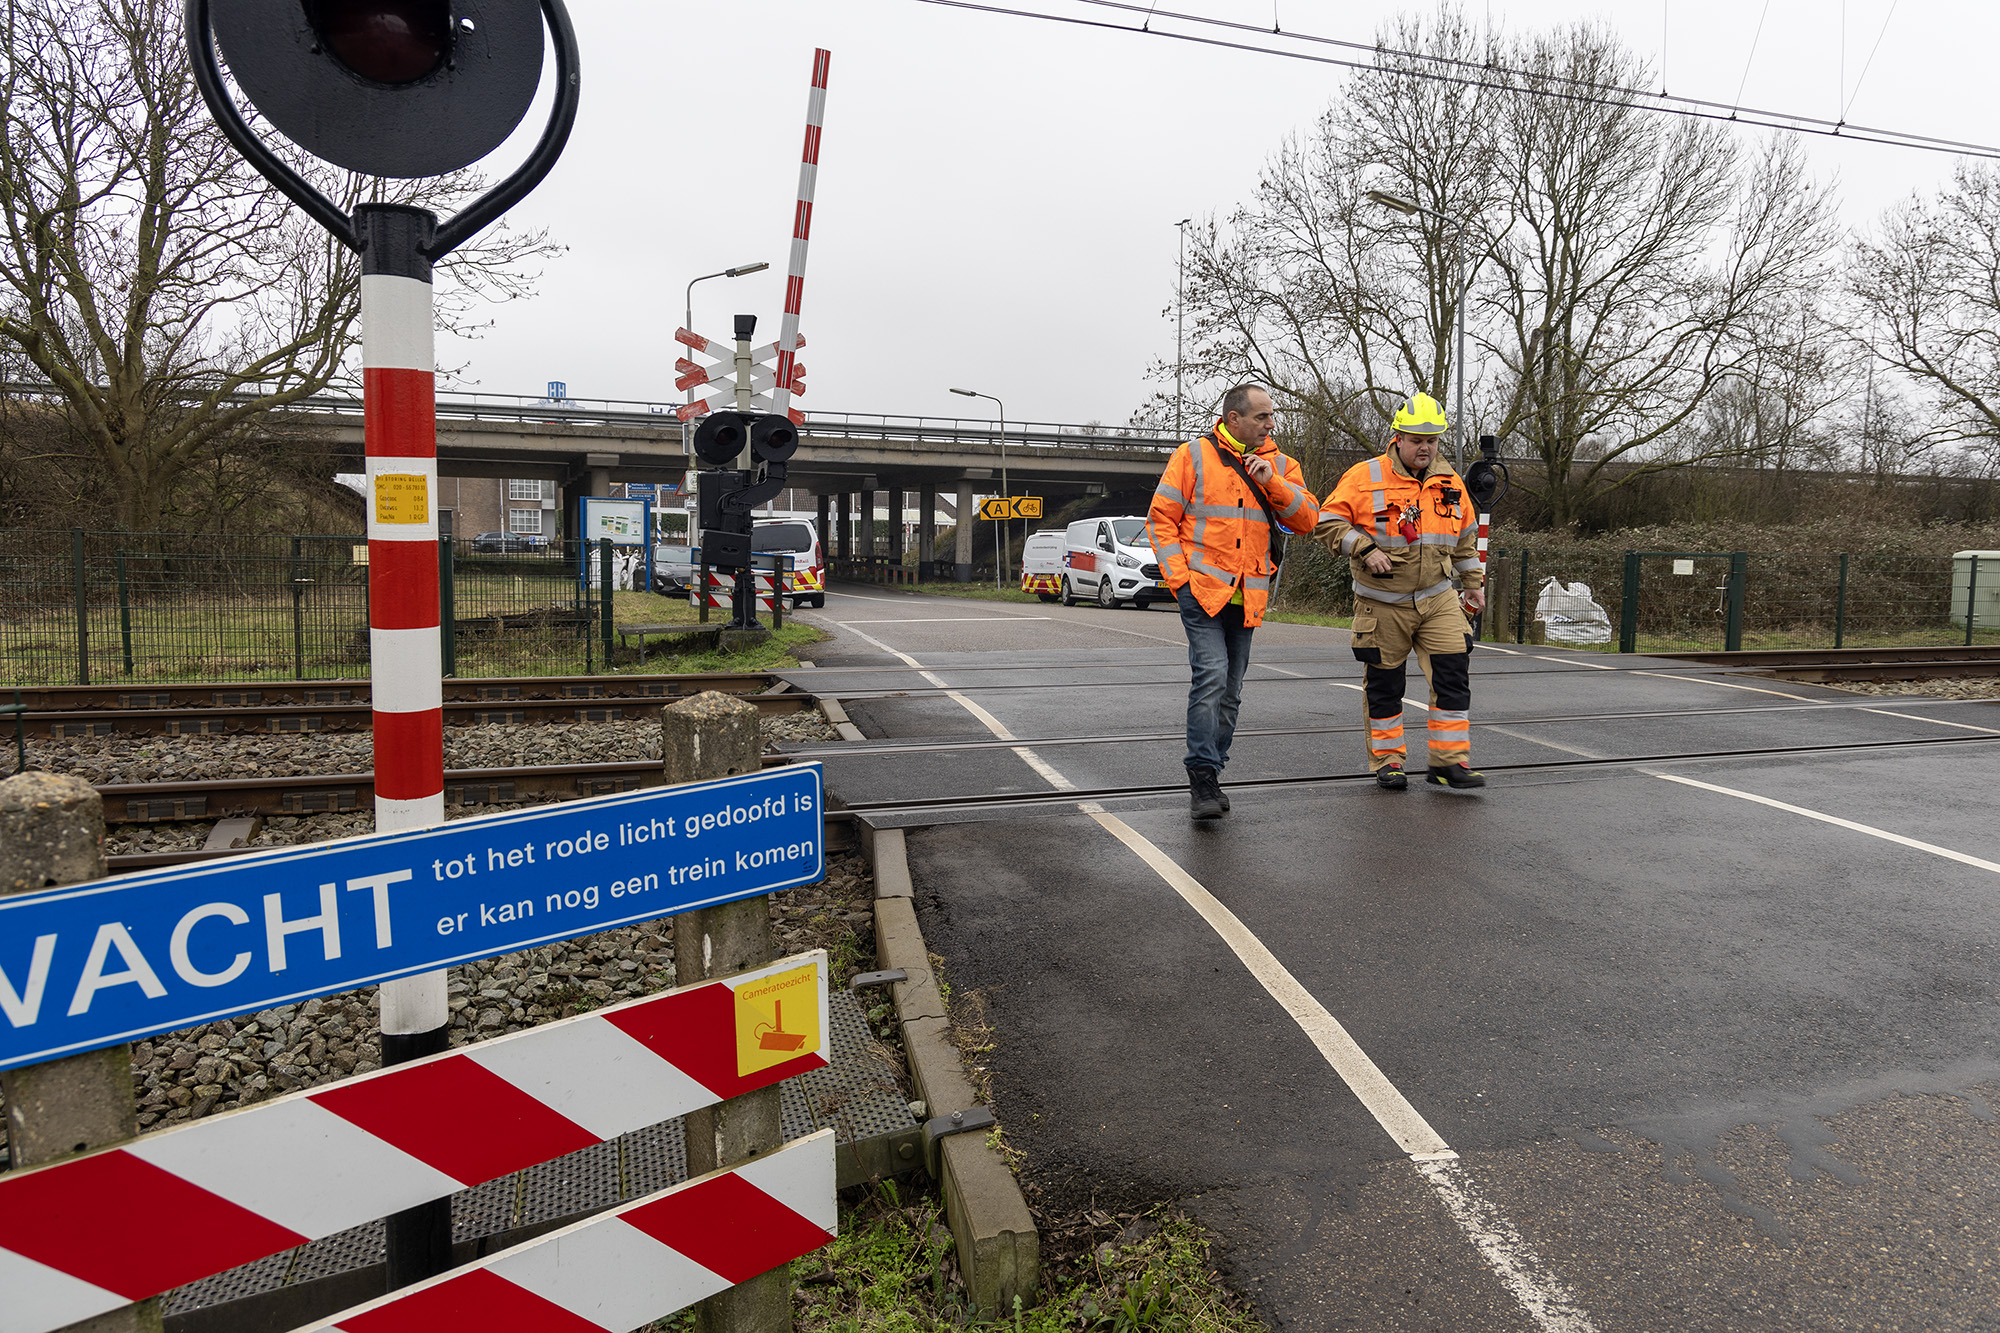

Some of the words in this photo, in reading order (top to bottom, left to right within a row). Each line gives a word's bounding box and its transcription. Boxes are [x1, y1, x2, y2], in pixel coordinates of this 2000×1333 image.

[994, 503, 1003, 515] A
[431, 853, 477, 881] tot
[487, 842, 536, 873] het
[546, 830, 610, 861] rode
[619, 816, 676, 847] licht
[684, 795, 787, 840] gedoofd
[794, 794, 814, 814] is
[436, 912, 469, 937] er
[481, 899, 535, 928] kan
[546, 885, 600, 914] nog
[610, 873, 660, 899] een
[668, 856, 727, 887] trein
[735, 840, 815, 873] komen
[742, 973, 812, 1001] Cameratoezicht
